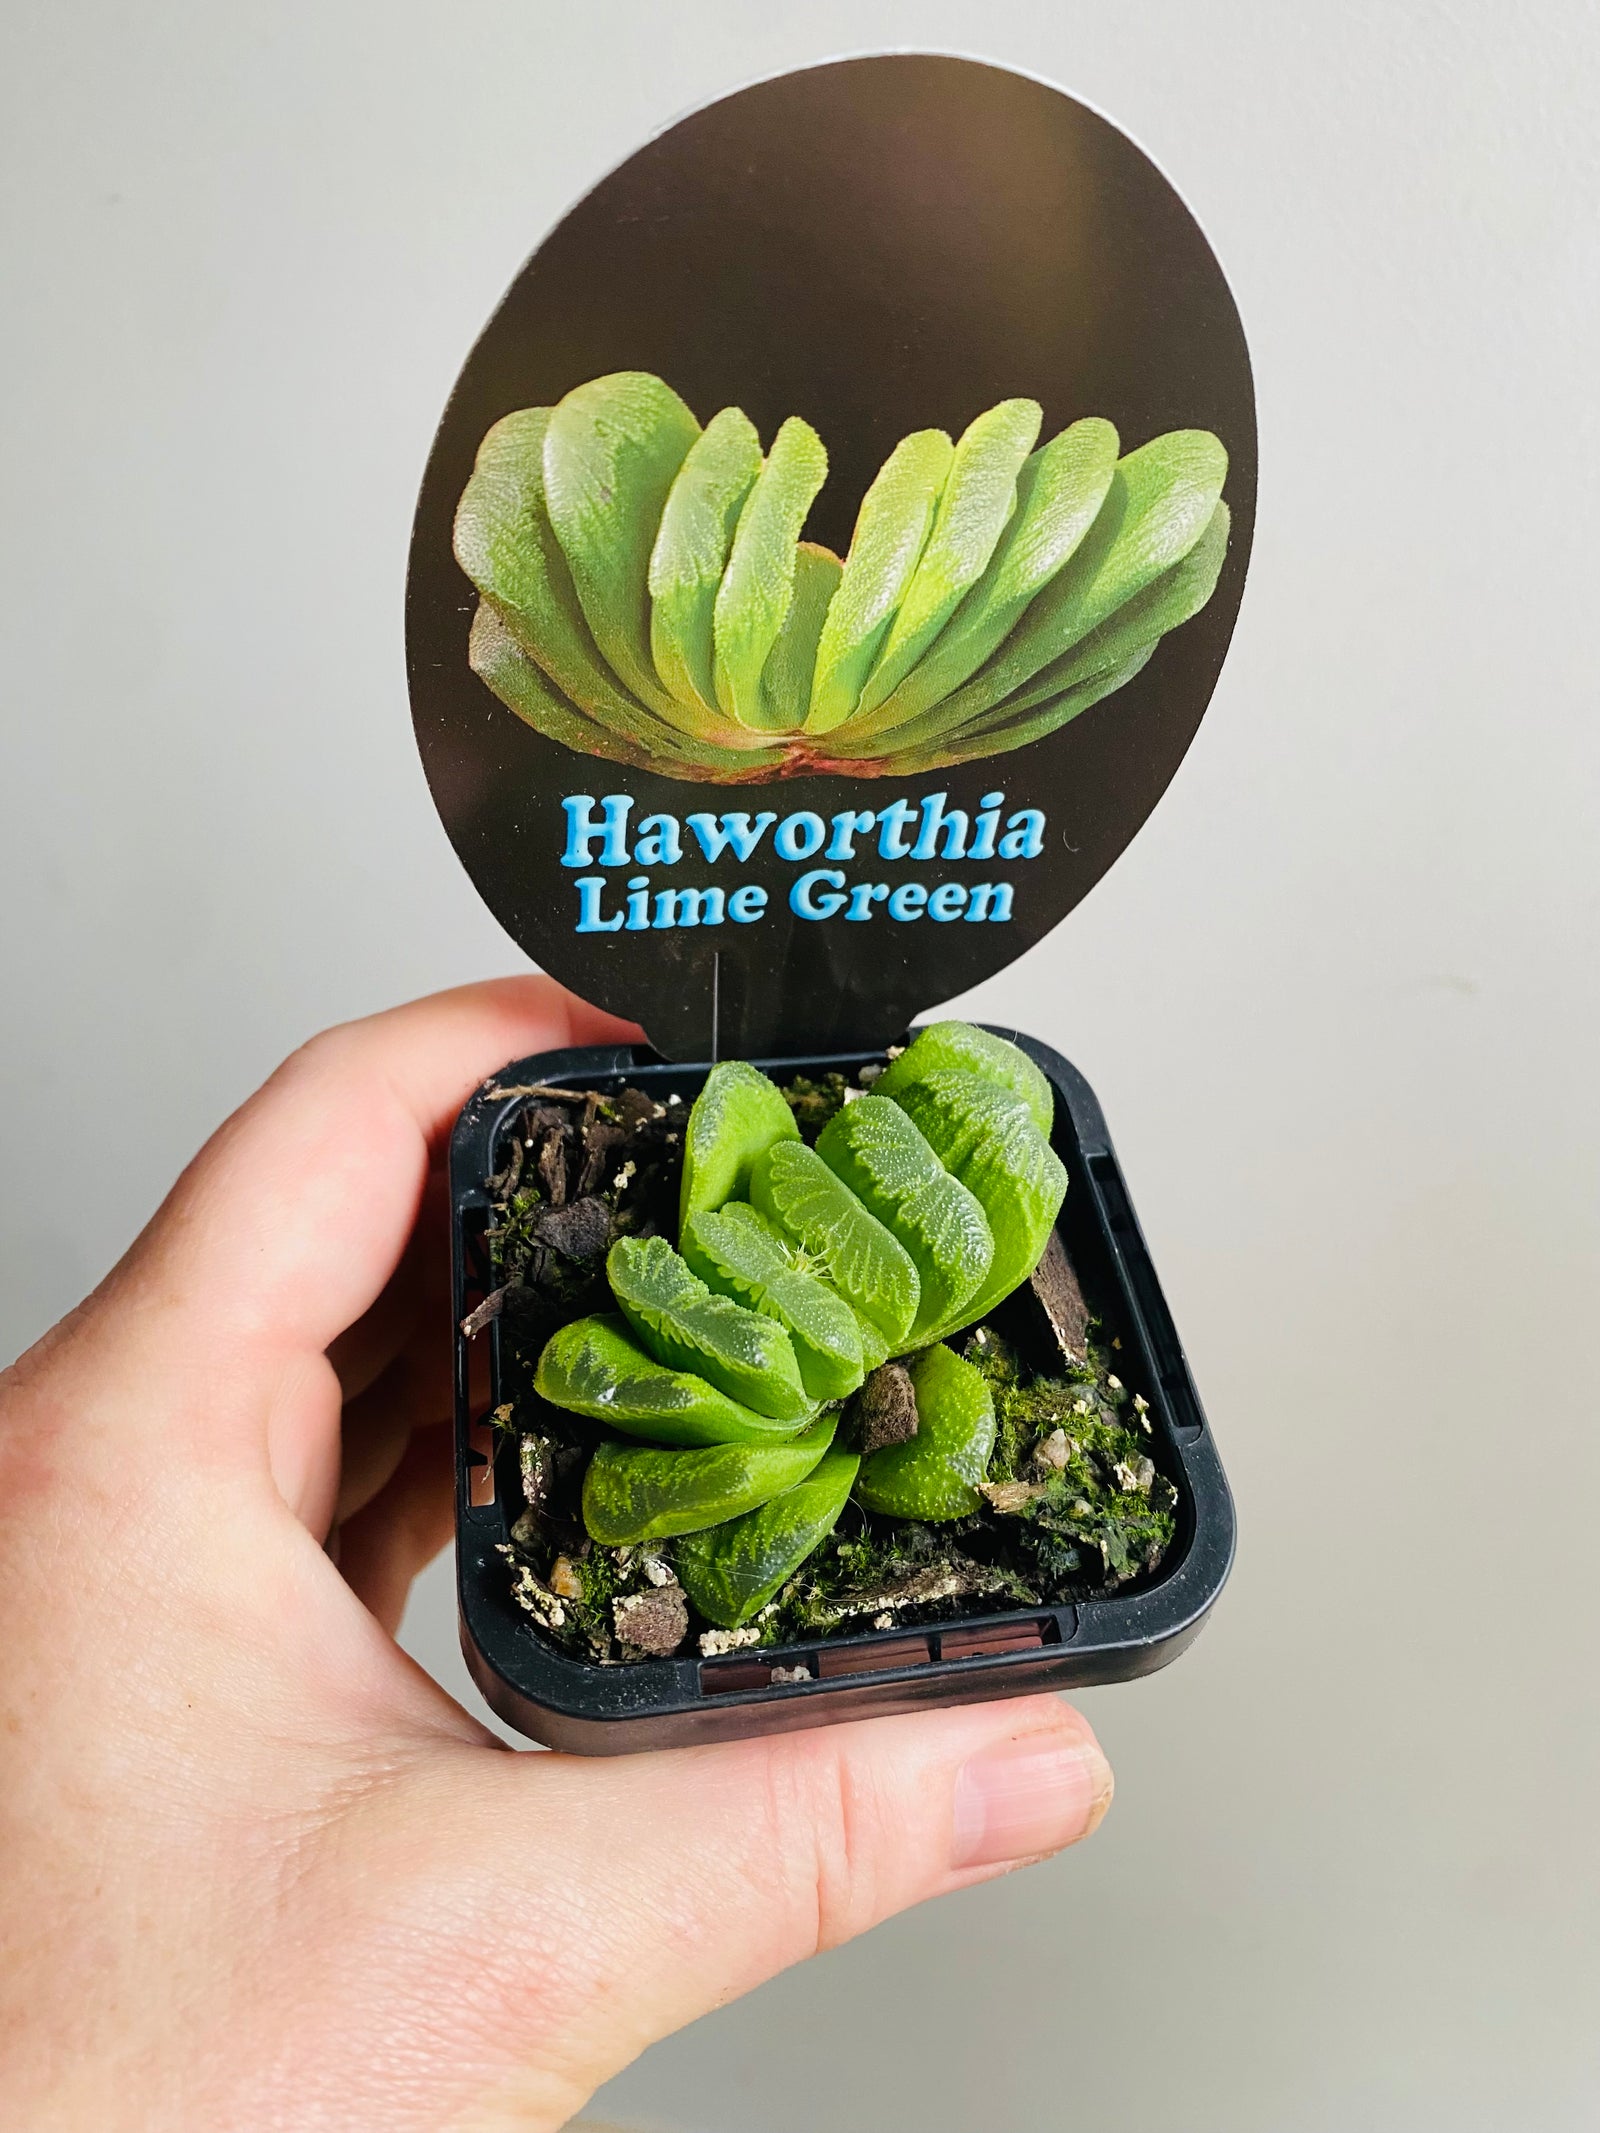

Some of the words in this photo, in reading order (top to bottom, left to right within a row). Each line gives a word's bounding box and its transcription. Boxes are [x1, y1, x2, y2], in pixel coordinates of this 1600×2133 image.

[560, 792, 1046, 868] Haworthia
[574, 876, 769, 933] Lime
[788, 869, 1015, 923] Green
